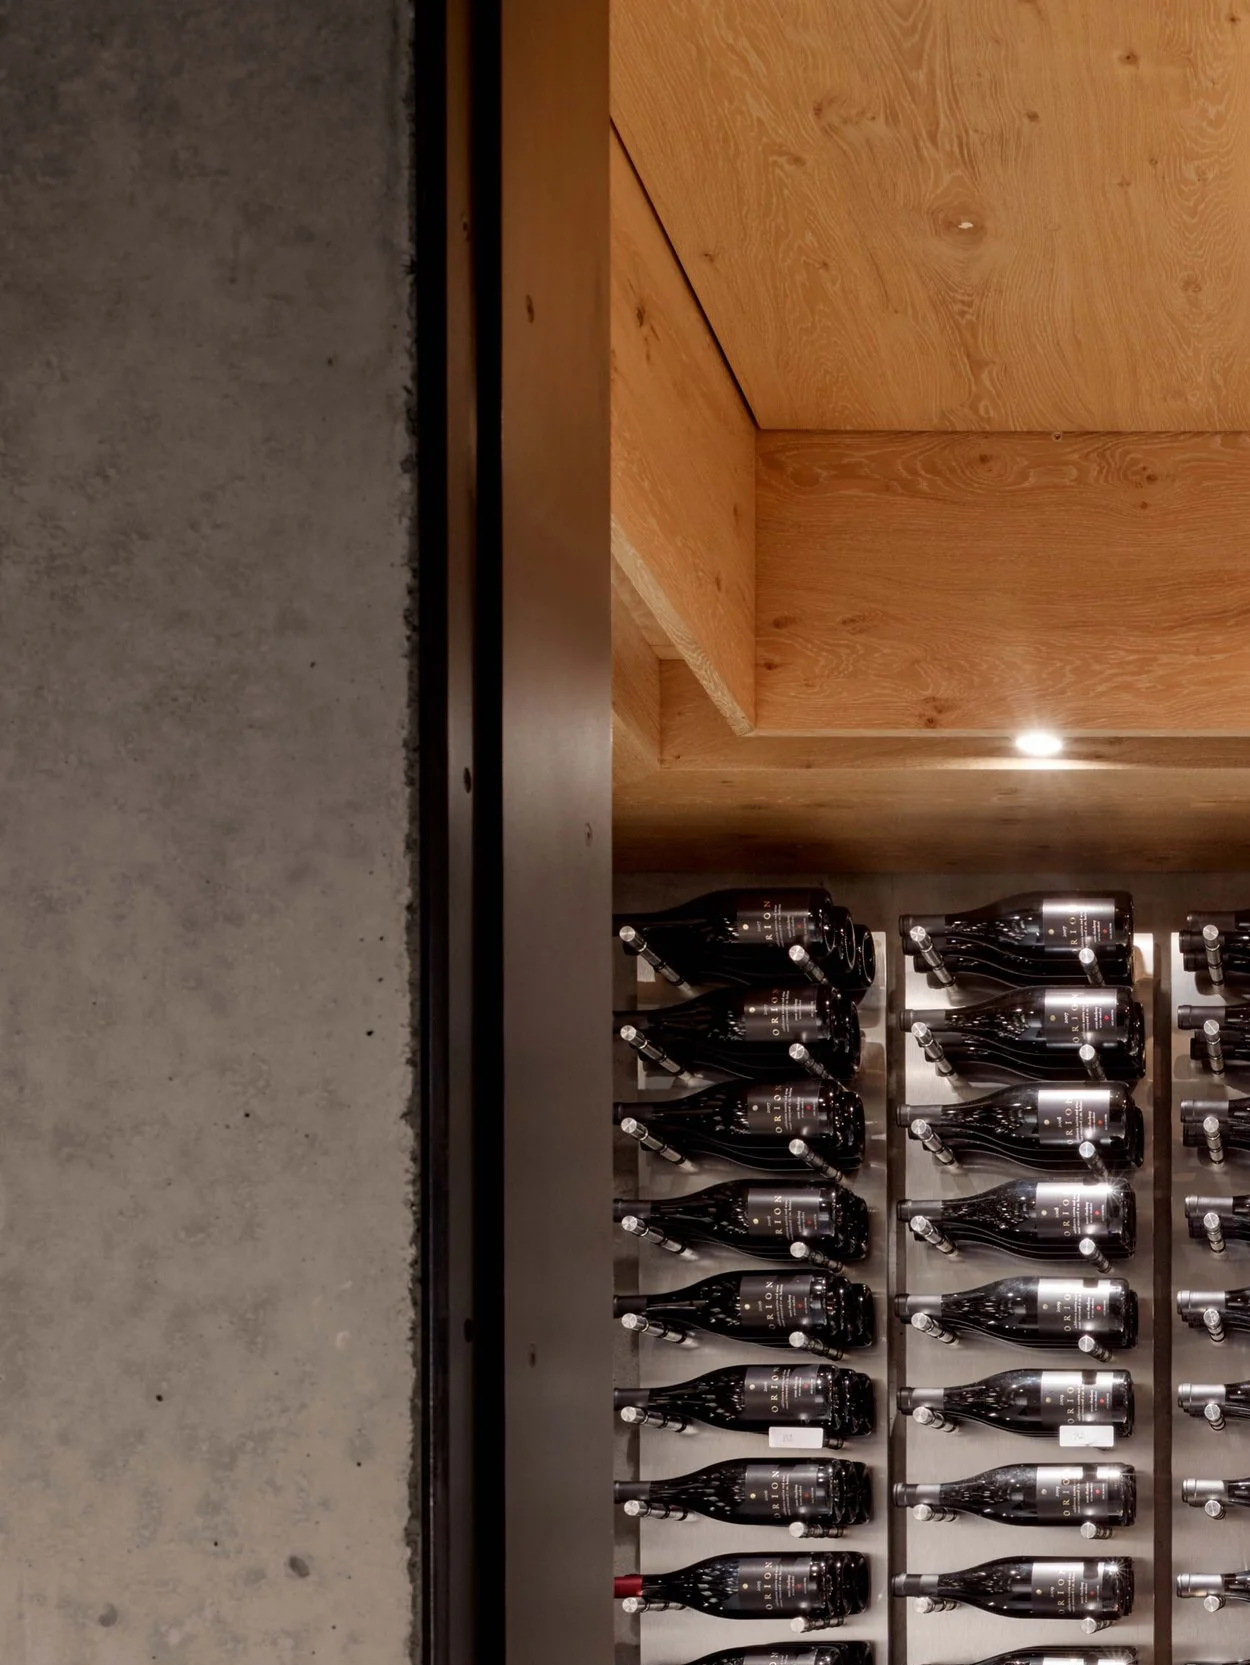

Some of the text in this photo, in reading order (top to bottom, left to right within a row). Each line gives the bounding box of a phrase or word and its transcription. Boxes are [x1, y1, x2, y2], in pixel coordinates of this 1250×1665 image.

[774, 1085, 782, 1134] ORION
[765, 1281, 776, 1330] ORION
[1066, 1386, 1075, 1424] ORIO
[771, 1470, 780, 1519] ORION
[1062, 1478, 1070, 1517] ORIO
[764, 1561, 773, 1611] ORION
